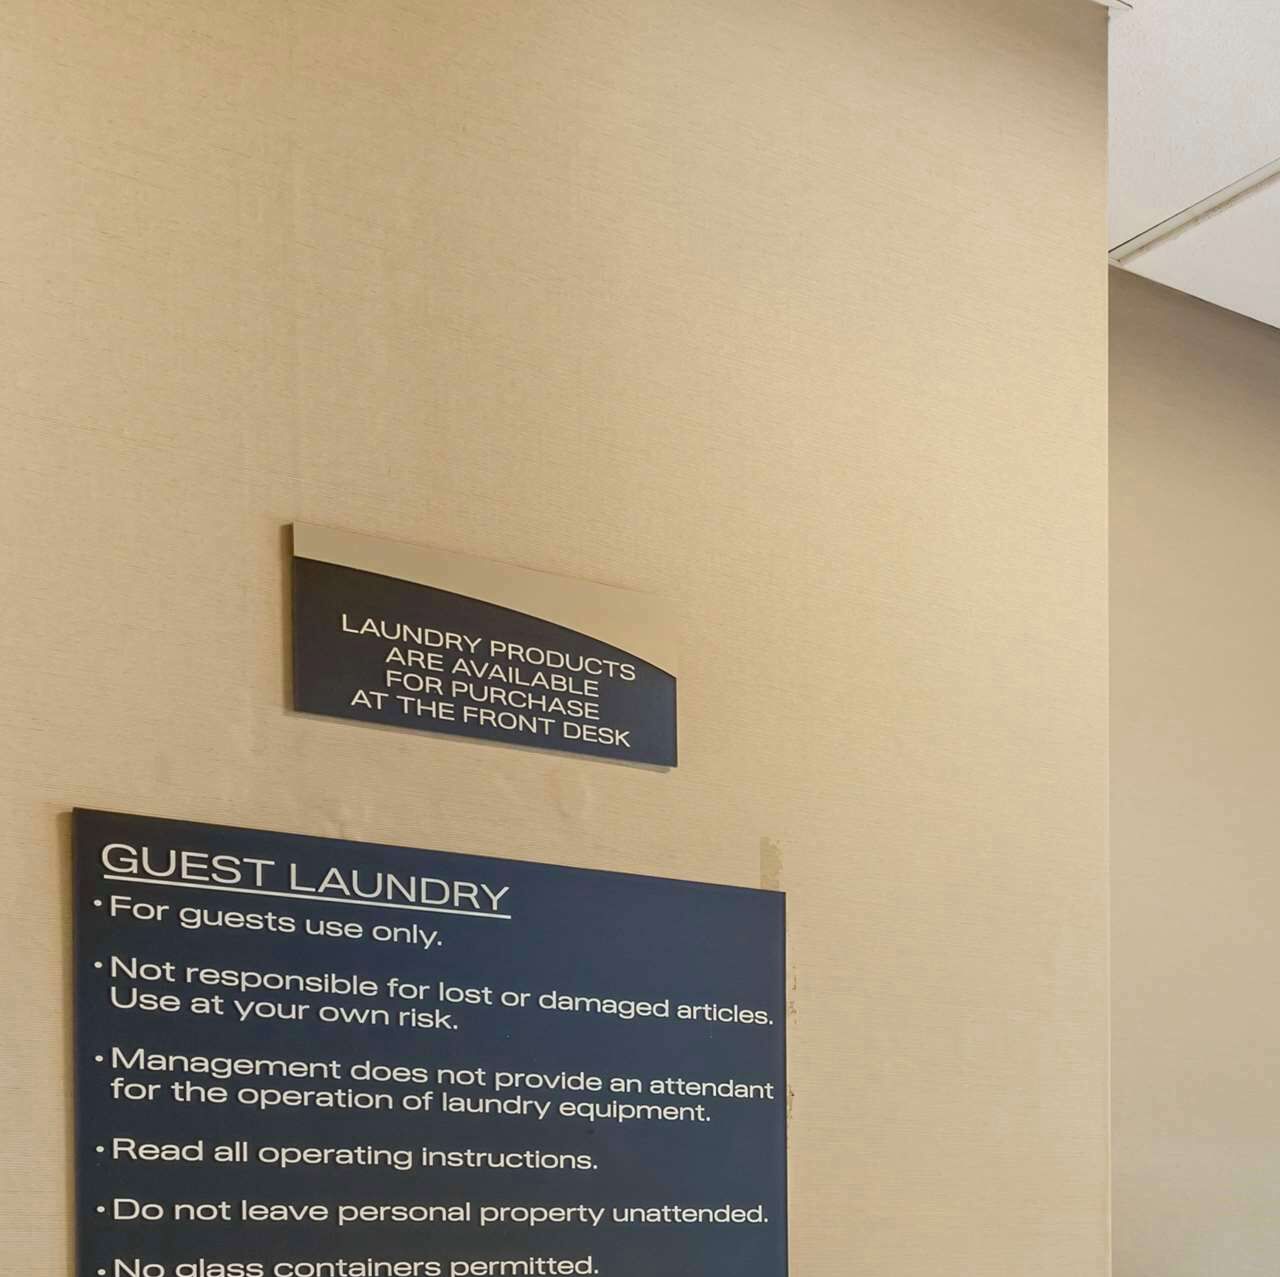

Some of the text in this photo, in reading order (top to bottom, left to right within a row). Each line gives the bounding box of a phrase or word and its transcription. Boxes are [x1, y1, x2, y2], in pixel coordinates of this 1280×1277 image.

[342, 613, 637, 682] LAUNDRY PRODUCTS
[385, 646, 600, 699] ARE AVAILABLE
[350, 689, 631, 748] AT THE FRONT DESK
[386, 669, 601, 721] FOR PURCHASE
[101, 843, 510, 911] GUEST LAUNDRY
[110, 895, 443, 950] For guests use only.
[111, 955, 774, 1025] Not responsible for lost or damaged articles.
[111, 986, 458, 1030] Use at your own risk.
[112, 1046, 775, 1100] Management does not provide an attendant
[110, 1077, 711, 1123] for the operation of laundry equipment.
[113, 1137, 598, 1171] Read all operating instructions.
[113, 1198, 769, 1227] Do not leave personal property unattended.
